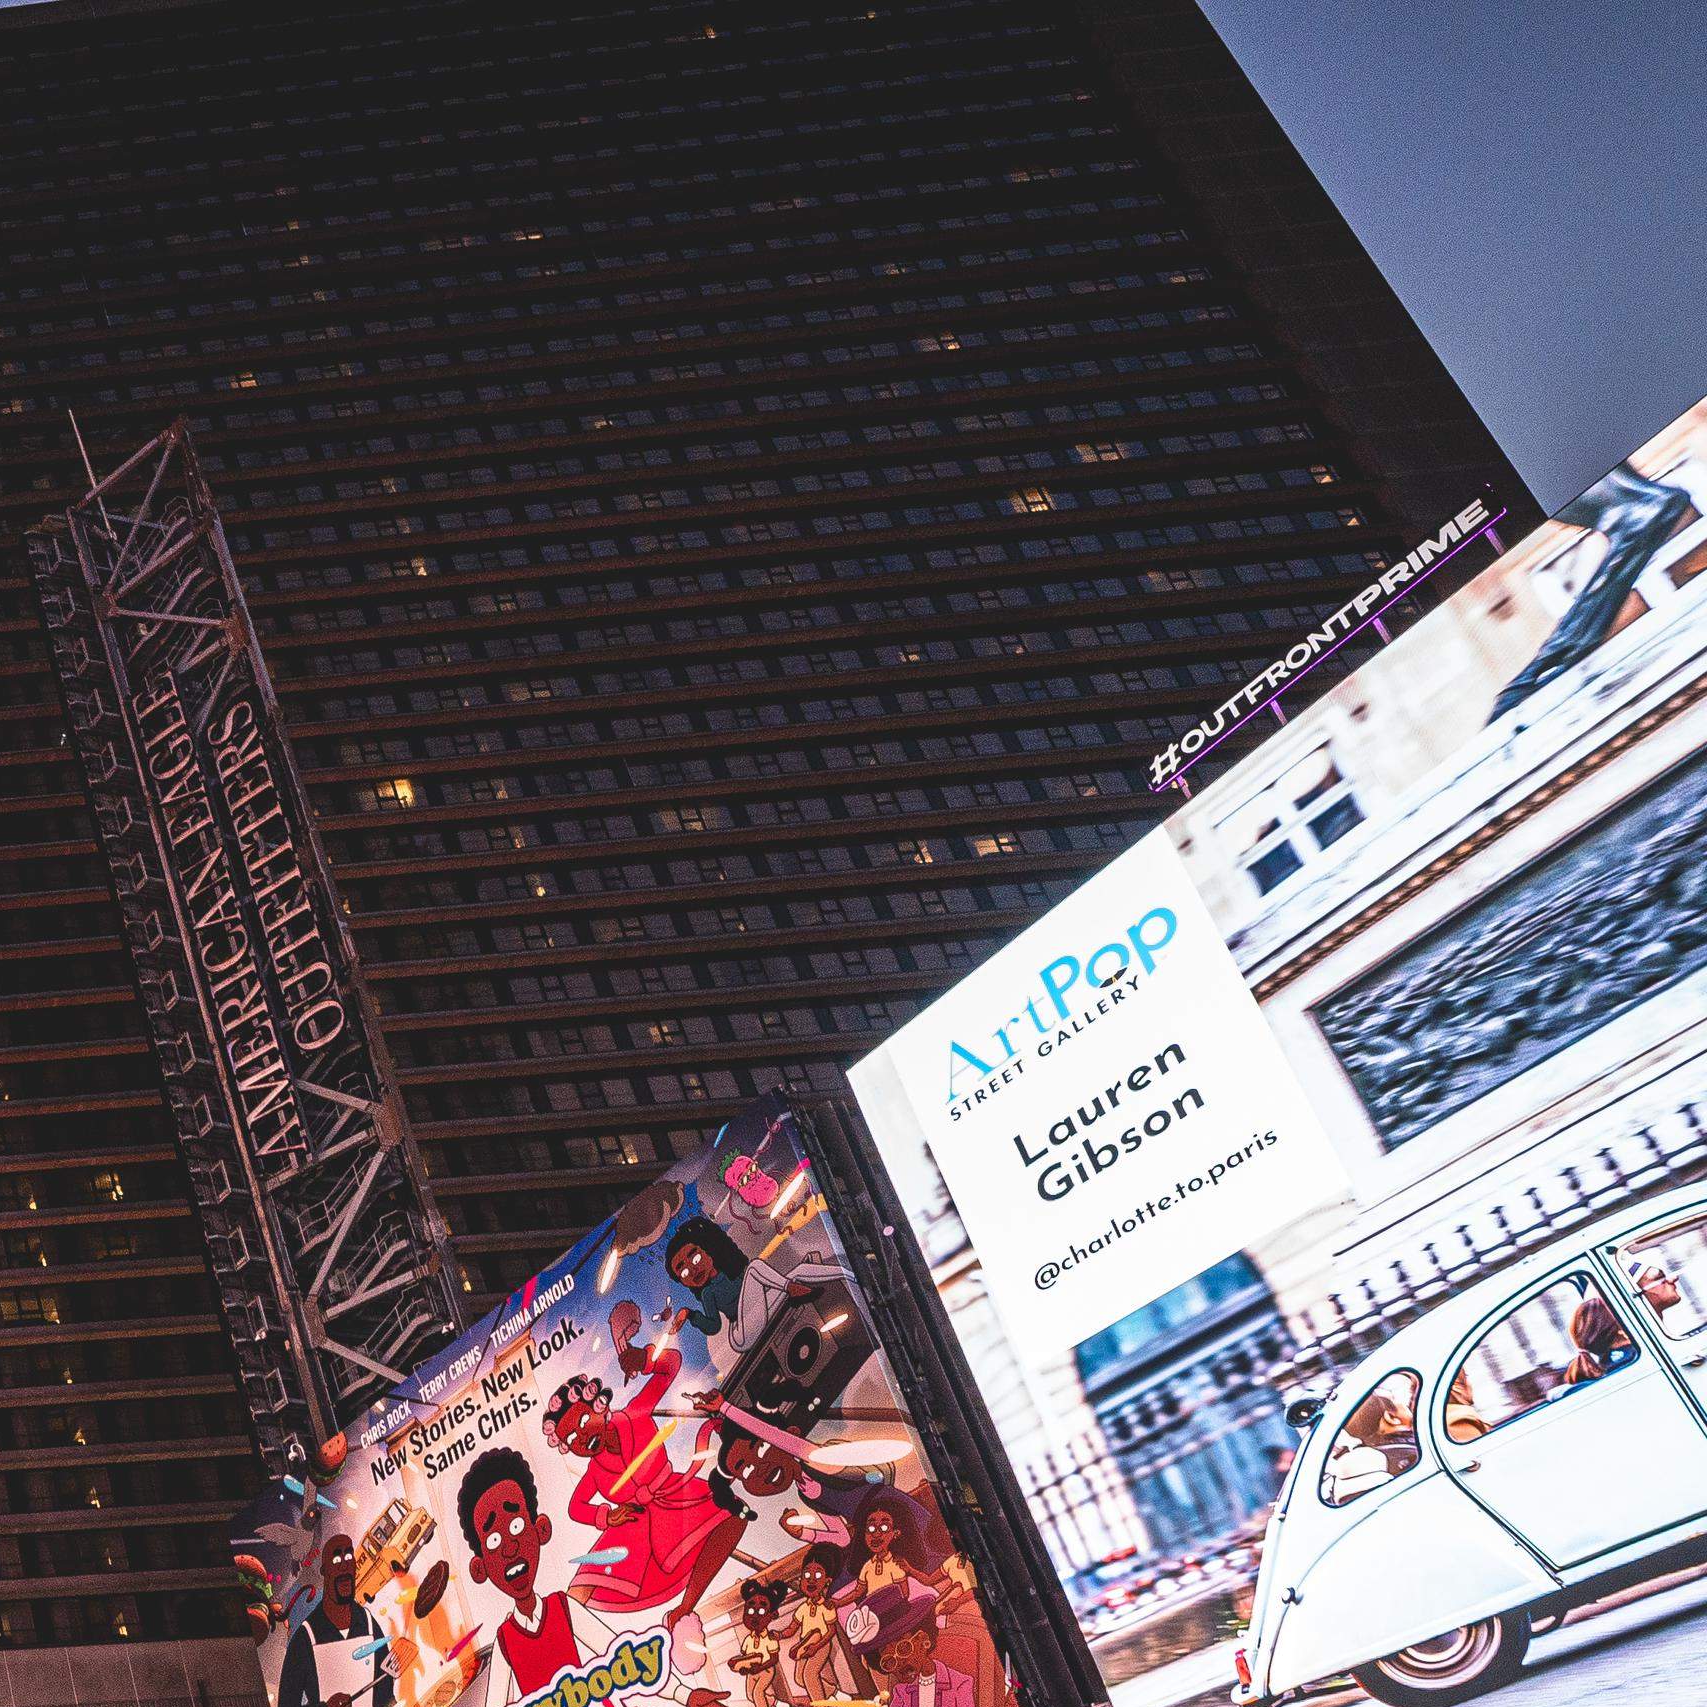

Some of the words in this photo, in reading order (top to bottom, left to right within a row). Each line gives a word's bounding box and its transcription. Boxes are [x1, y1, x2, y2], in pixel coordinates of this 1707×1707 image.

[1148, 499, 1491, 785] #OUTFRONTPRIME
[944, 903, 1178, 1101] ArtPop
[949, 1058, 1028, 1123] STREET
[1037, 975, 1142, 1060] GALLERY
[1013, 1040, 1187, 1167] Lauren
[1035, 1088, 1206, 1203] Gibson
[1034, 1125, 1279, 1292] @charlotte.to.paris
[360, 1426, 387, 1450] CHRIS
[387, 1400, 412, 1430] ROCK
[418, 1374, 447, 1403] TERRY
[448, 1345, 482, 1380] CREWS
[490, 1308, 532, 1348] TICHINA
[534, 1274, 575, 1318] ARNOLD
[370, 1448, 407, 1486] New
[409, 1397, 482, 1455] Stories.
[480, 1360, 524, 1403] New
[525, 1316, 584, 1370] Look.
[423, 1432, 476, 1480] Same
[477, 1391, 538, 1441] Chris.
